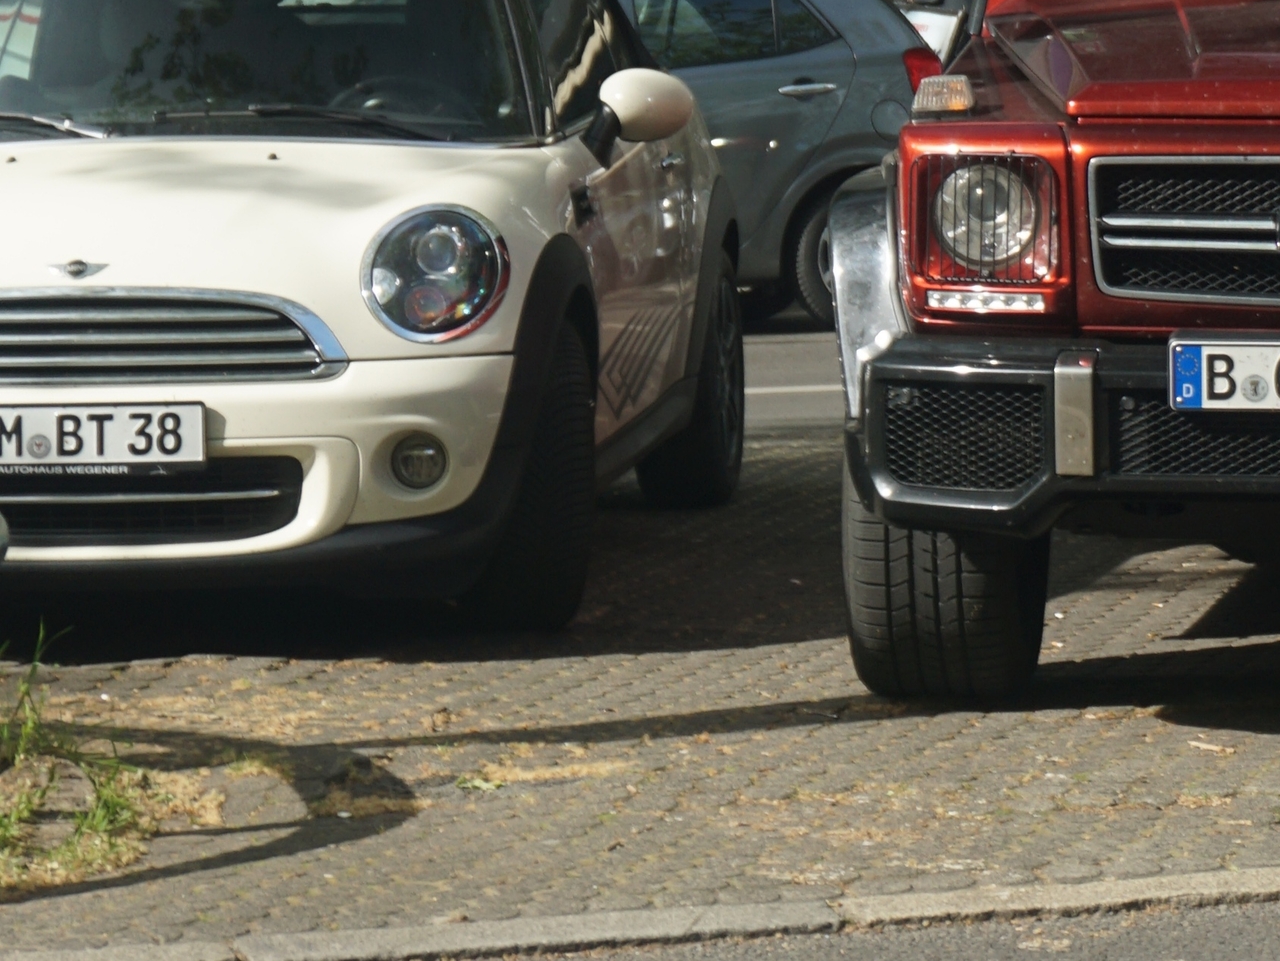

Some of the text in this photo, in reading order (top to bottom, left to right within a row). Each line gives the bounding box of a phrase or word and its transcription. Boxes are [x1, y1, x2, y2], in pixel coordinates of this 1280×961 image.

[1182, 383, 1194, 397] D
[1206, 353, 1237, 401] B
[56, 413, 114, 456] BT
[127, 412, 183, 456] 38
[65, 465, 129, 475] WEGENER
